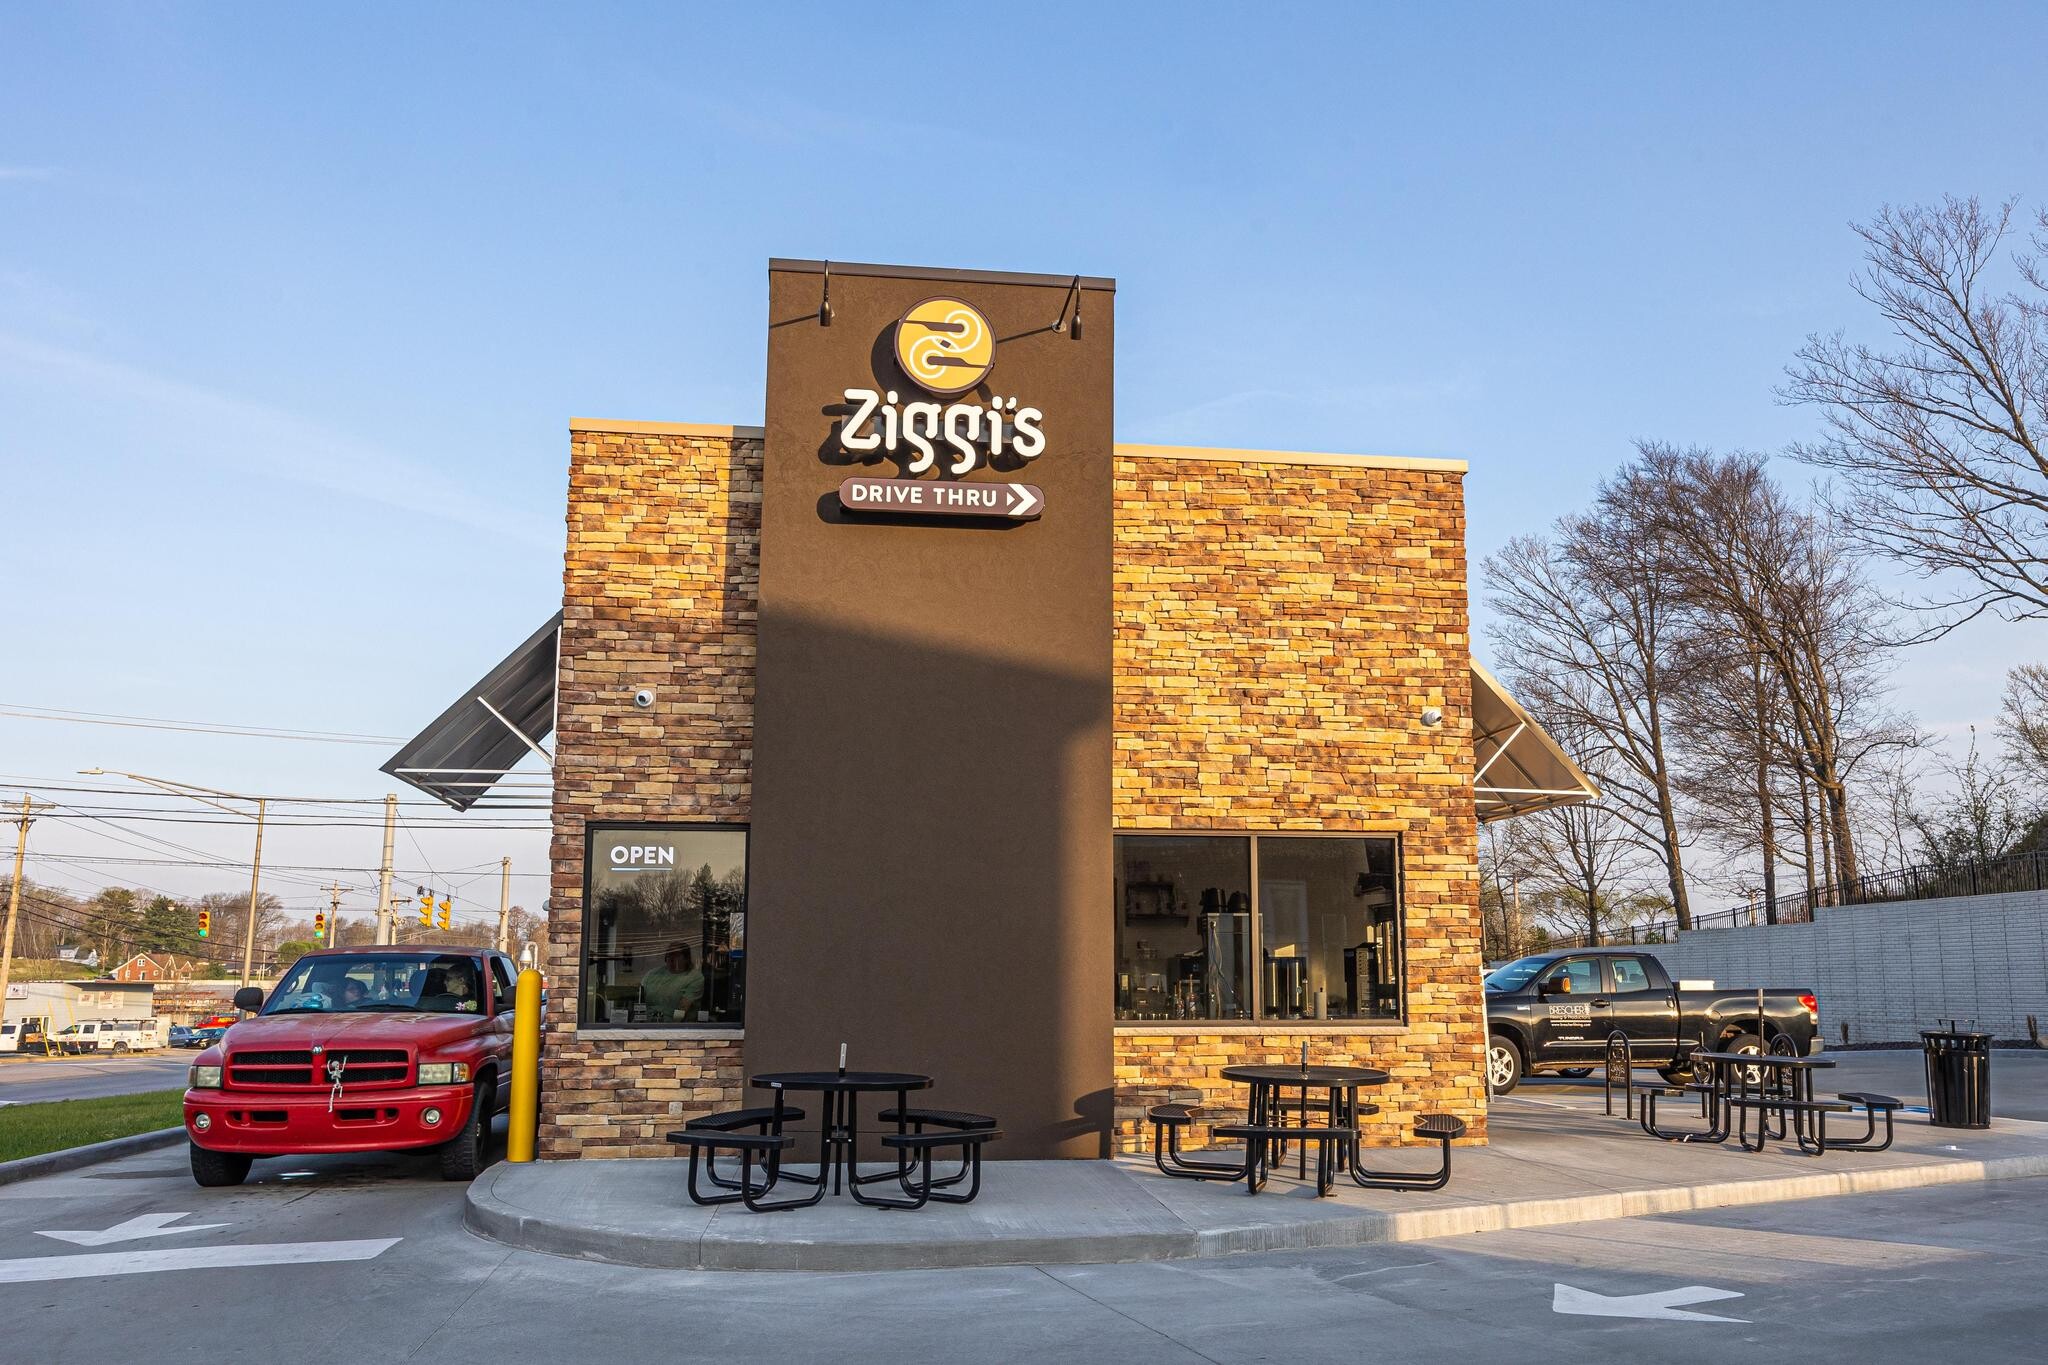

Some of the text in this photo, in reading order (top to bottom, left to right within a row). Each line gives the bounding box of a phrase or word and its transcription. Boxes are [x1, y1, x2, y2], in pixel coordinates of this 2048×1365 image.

[841, 388, 1046, 475] Ziggi's
[852, 484, 997, 507] DRIVE THRU
[610, 845, 674, 865] OPEN
[1549, 1005, 1585, 1015] BRESCHER
